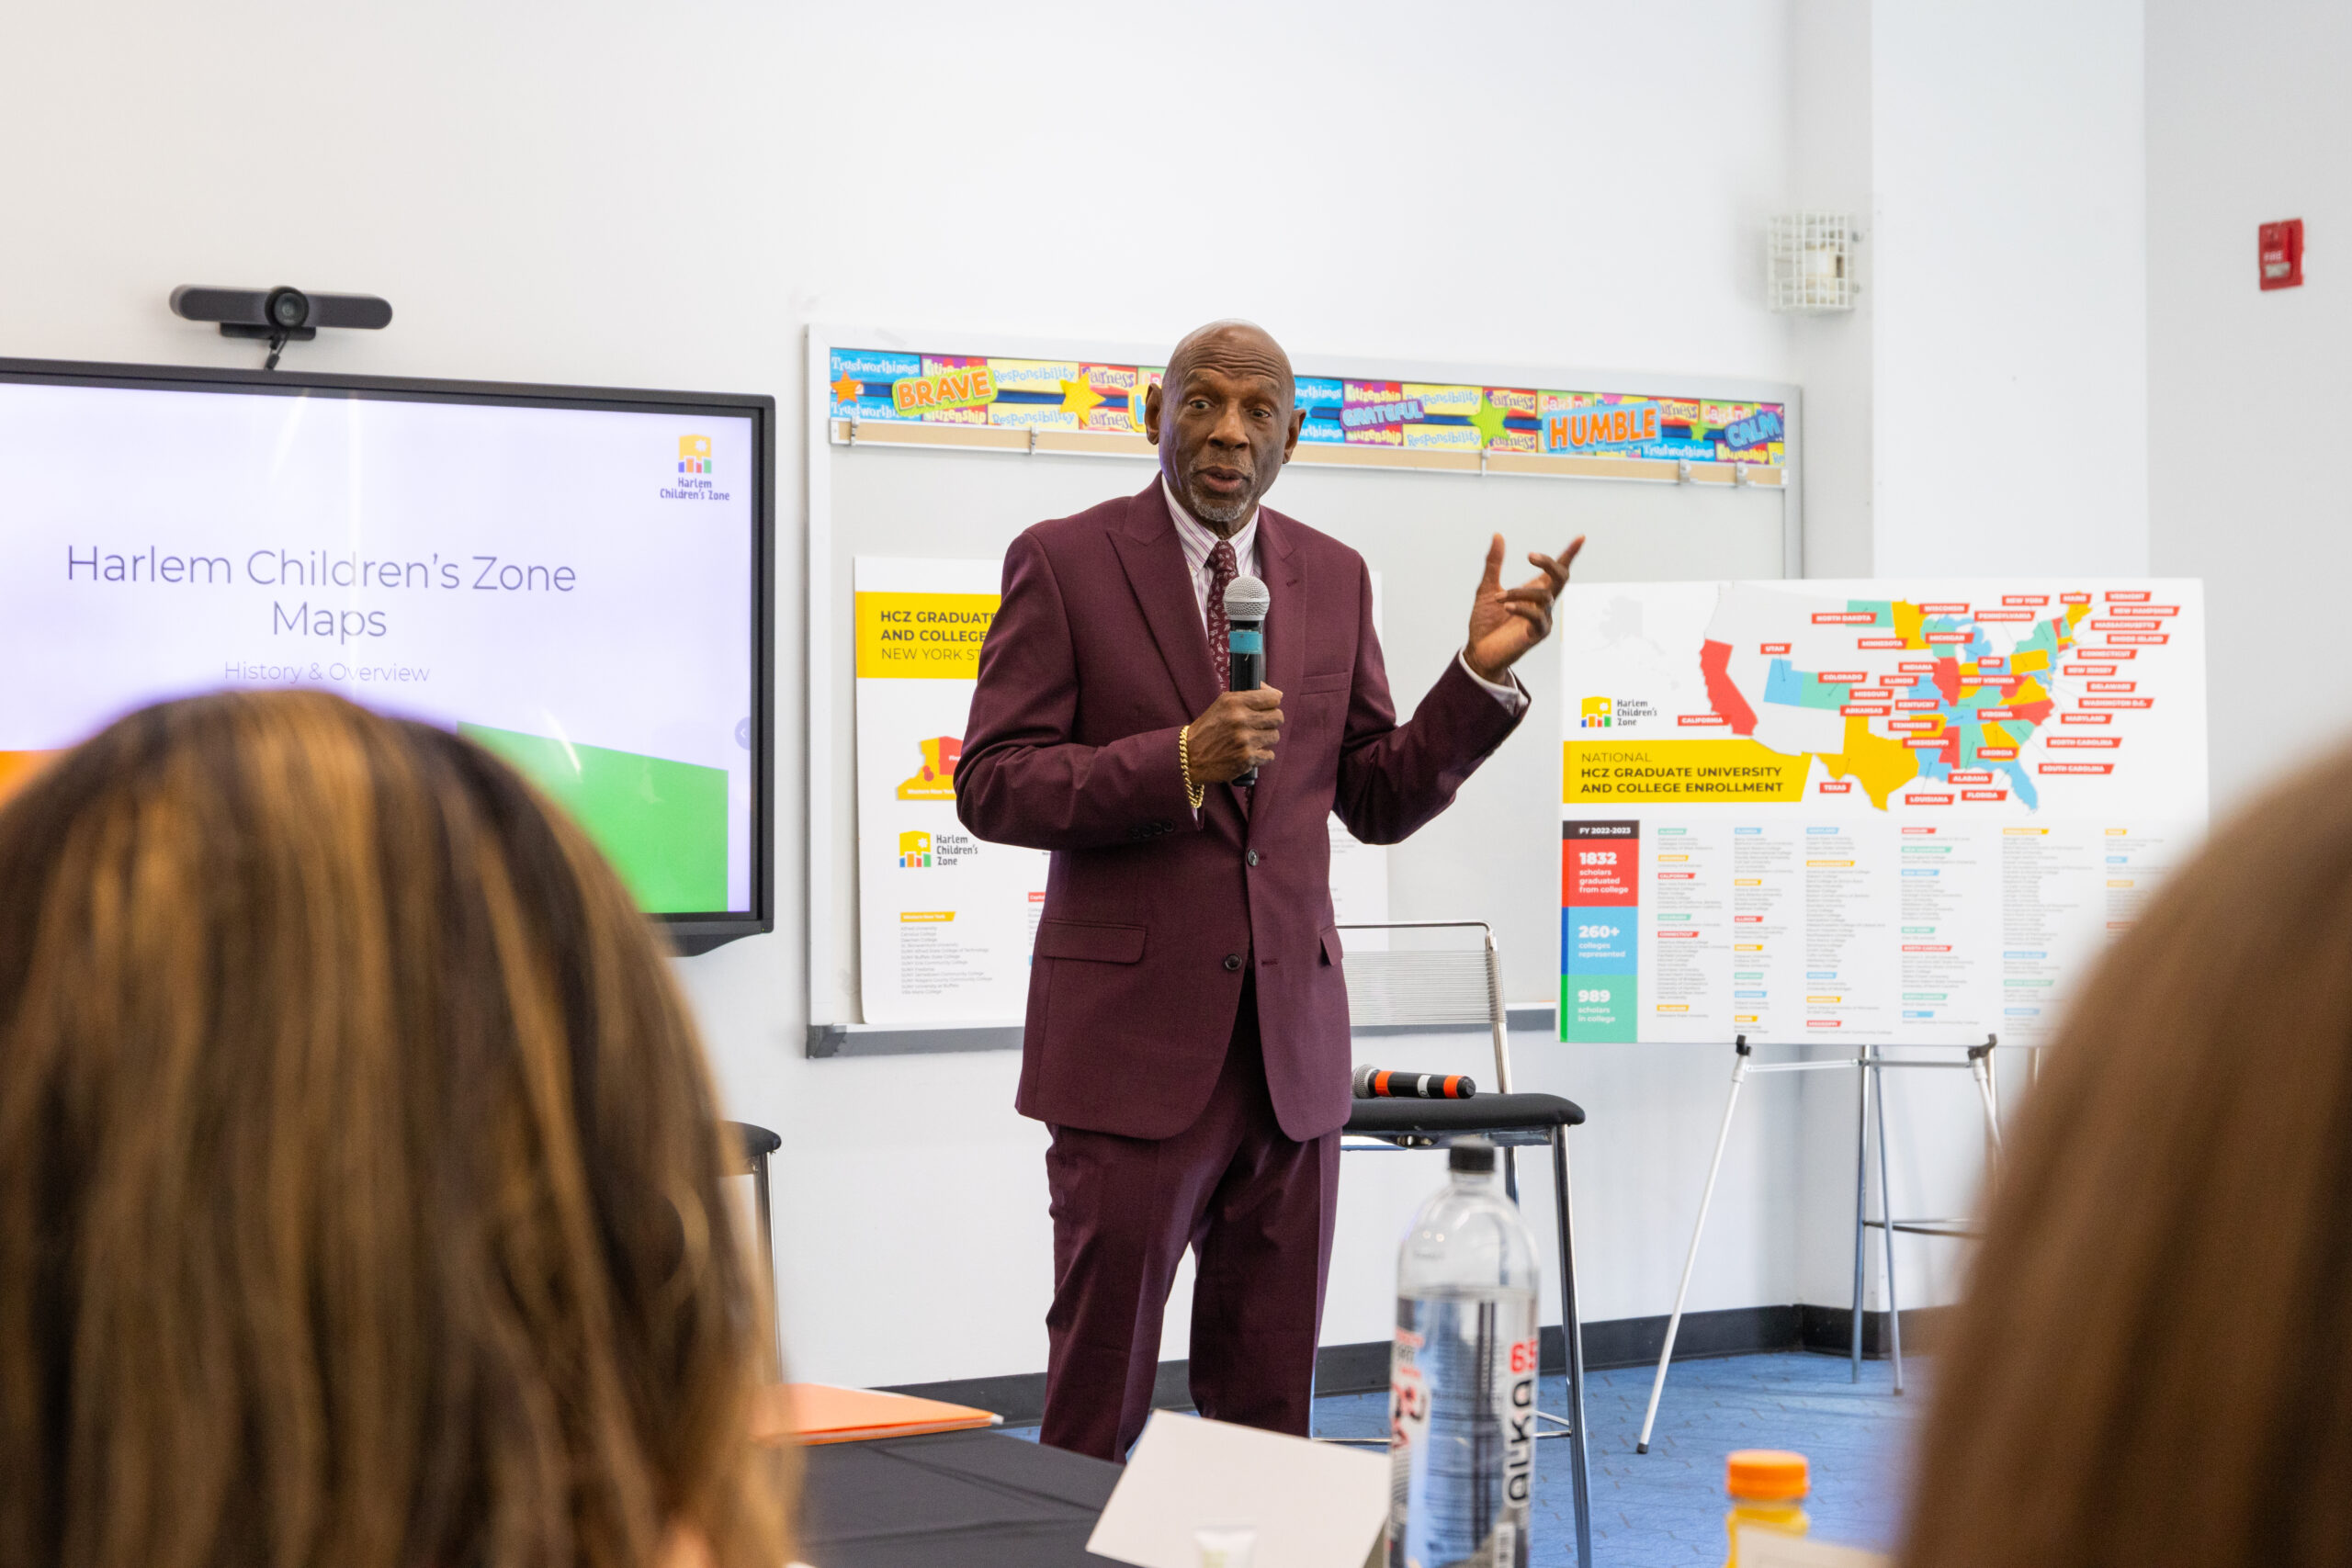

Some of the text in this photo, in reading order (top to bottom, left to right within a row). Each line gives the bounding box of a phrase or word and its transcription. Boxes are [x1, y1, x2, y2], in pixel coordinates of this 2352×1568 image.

[831, 356, 919, 375] Trustworthiness
[993, 366, 1075, 384] Responsibility
[898, 371, 991, 409] BRAVE
[1345, 384, 1402, 402] Citizenship
[1342, 400, 1423, 427] GRATEFUL
[1550, 408, 1657, 449] HUMBLE
[1727, 413, 1781, 447] CALM
[1407, 430, 1480, 447] Responsibility
[678, 477, 712, 488] Harlem
[708, 490, 729, 501] Zone
[69, 546, 231, 583] Harlem
[472, 556, 576, 592] Zone
[881, 611, 911, 622] HCZ
[274, 601, 387, 645] Maps
[881, 629, 914, 641] AND
[882, 649, 917, 660] NEW
[922, 649, 962, 660] YORK
[225, 661, 430, 683] History & Overview
[1617, 699, 1647, 707] Harlem
[1581, 752, 1652, 762] NATIONAL
[1581, 766, 1782, 778] HCZ GRADUATE UNIVERSITY
[1581, 782, 1783, 793] AND COLLEGE ENROLLMENT
[936, 834, 967, 843] Harlem
[937, 856, 957, 865] Zone
[1579, 852, 1617, 865] 1832
[1579, 877, 1620, 886] graduated
[1600, 886, 1629, 895] college
[1578, 925, 1620, 938] 260+
[1578, 942, 1611, 950] colleges
[1578, 989, 1611, 1003] 989
[1588, 1015, 1615, 1023] college
